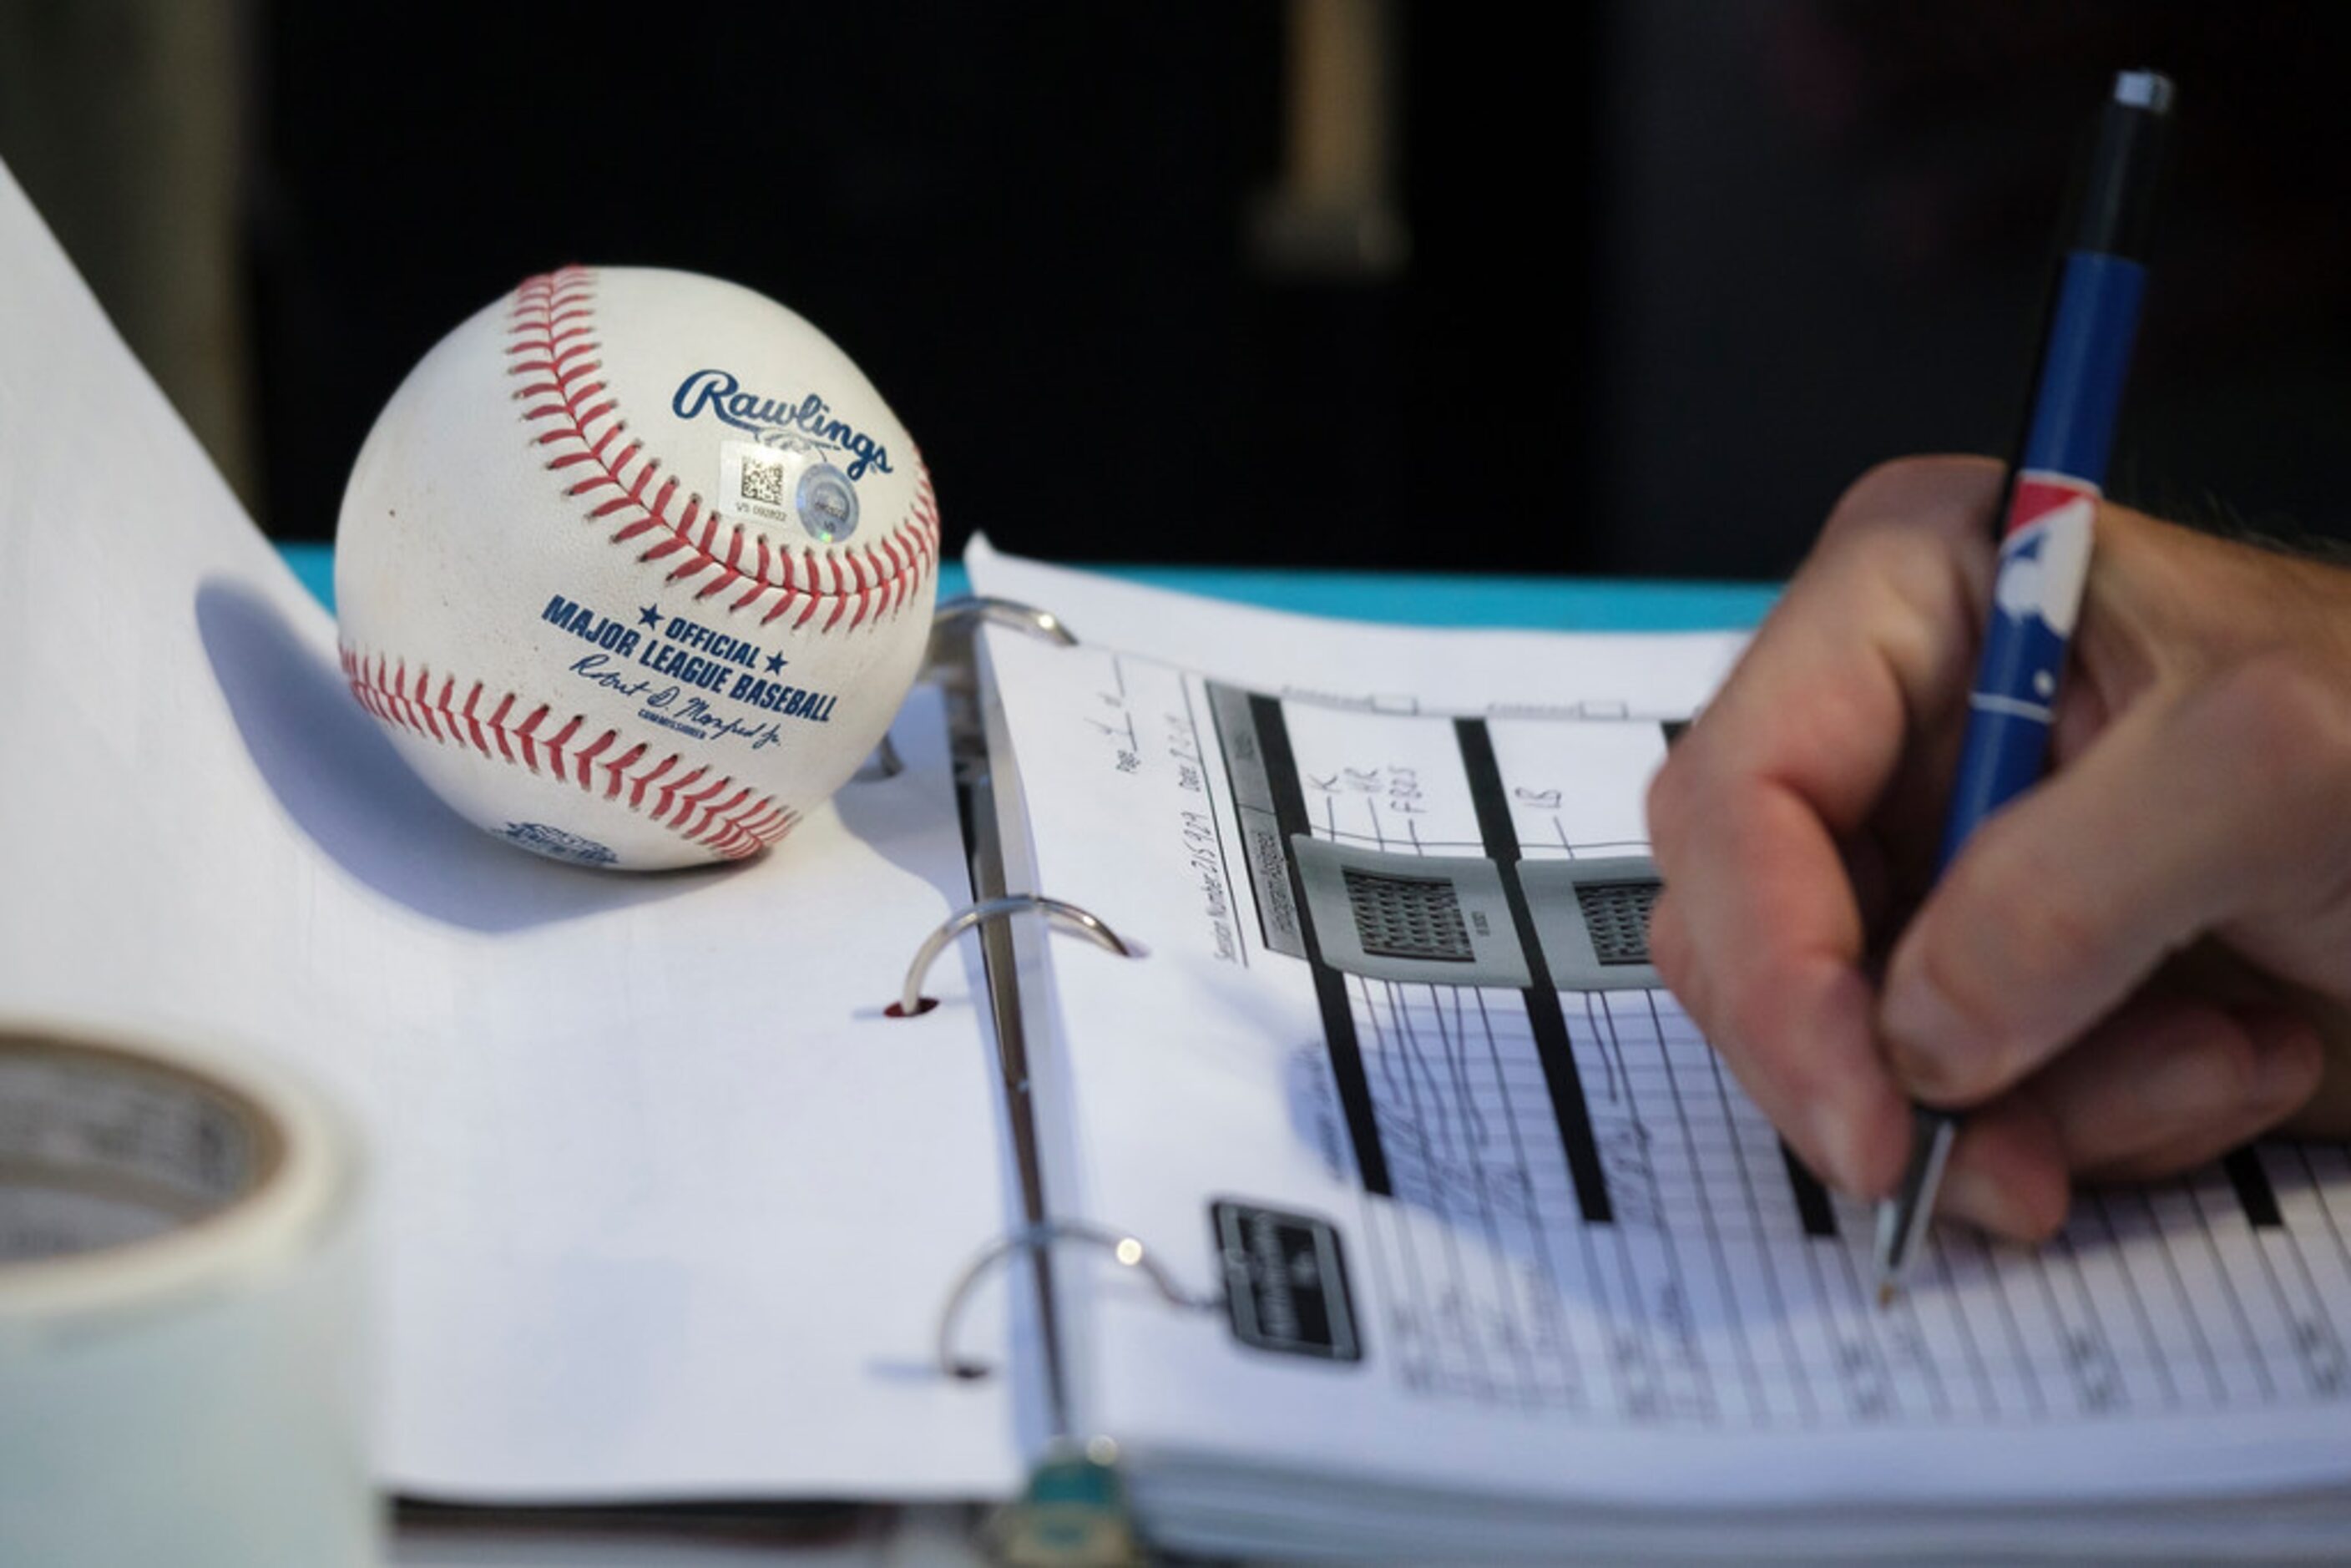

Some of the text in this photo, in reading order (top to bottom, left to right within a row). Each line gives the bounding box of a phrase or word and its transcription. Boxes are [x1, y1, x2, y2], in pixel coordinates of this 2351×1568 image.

[672, 369, 893, 480] Rawlings
[541, 594, 838, 722] MAJOR LEAGUE BASEBALL
[665, 617, 761, 669] OFFICIAL
